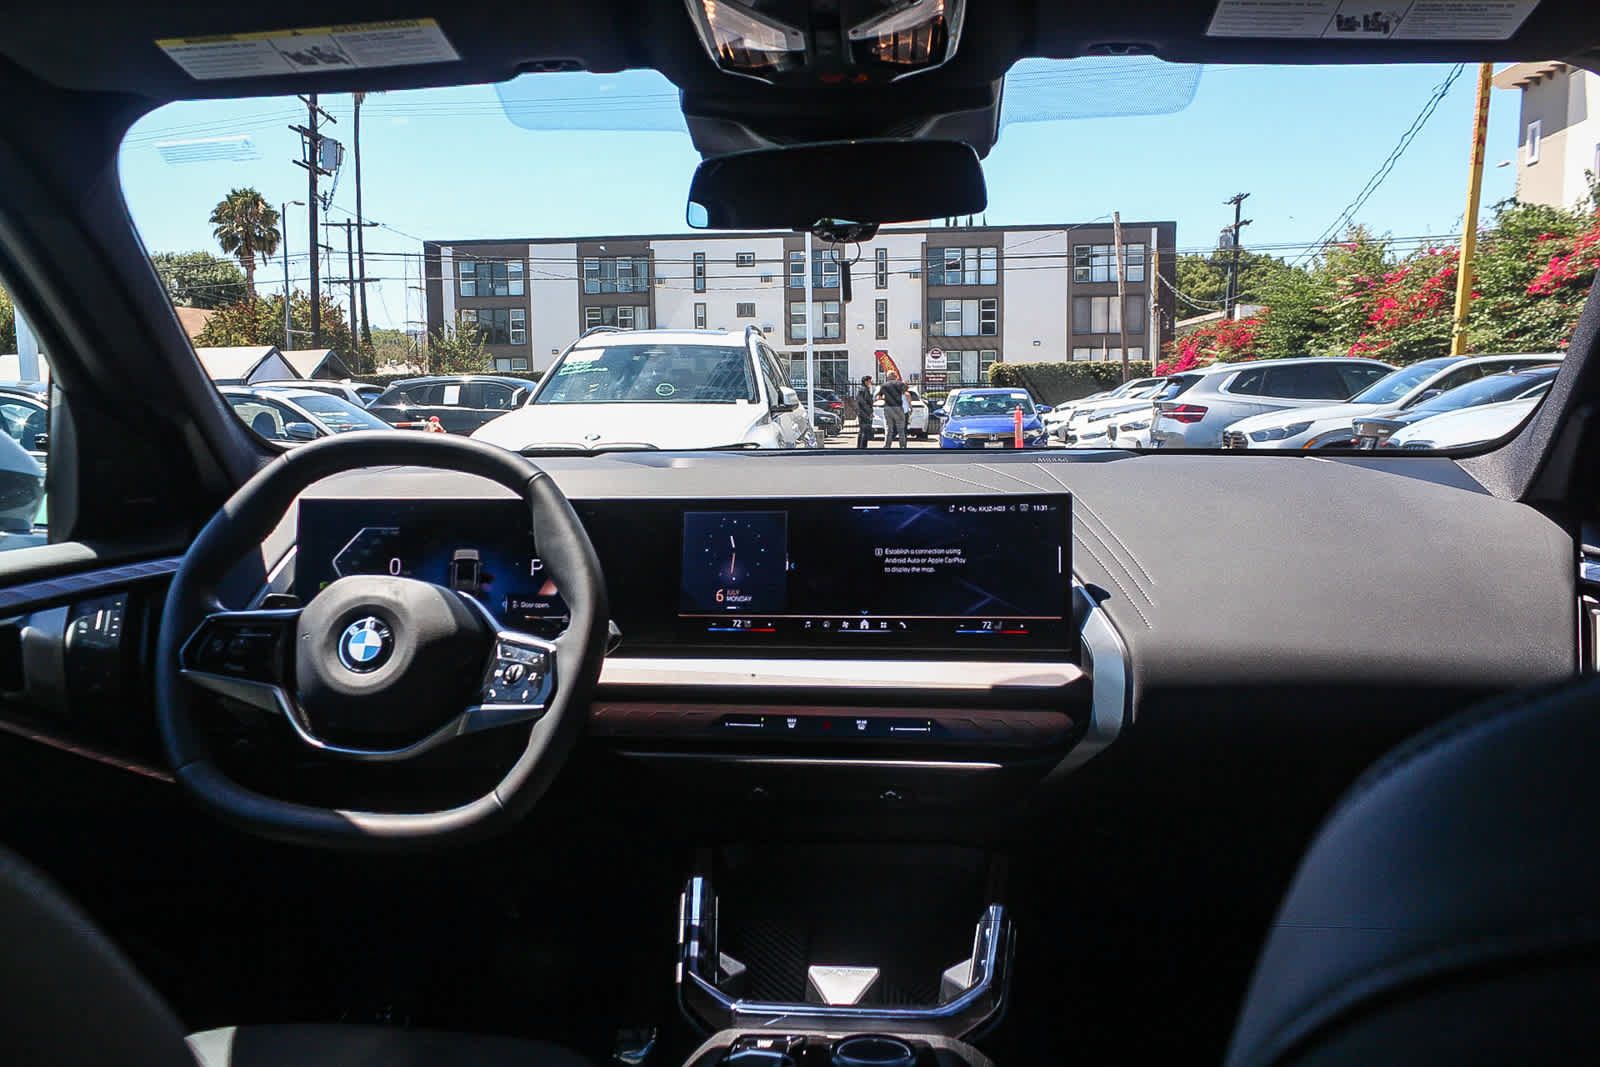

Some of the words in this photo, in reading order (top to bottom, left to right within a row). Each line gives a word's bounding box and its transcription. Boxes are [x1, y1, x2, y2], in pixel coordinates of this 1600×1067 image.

[885, 548, 910, 556] Establish
[915, 548, 944, 556] connection
[945, 549, 961, 557] using
[884, 557, 907, 565] Android
[907, 557, 921, 565] Auto
[927, 557, 944, 566] Apple
[944, 557, 967, 566] CarPlay
[389, 557, 401, 576] 0
[529, 558, 544, 576] P
[891, 566, 910, 575] display
[911, 566, 921, 574] the
[716, 588, 724, 602] 6
[726, 594, 753, 602] MONDAY
[520, 600, 534, 609] Door
[347, 615, 392, 638] BMW
[732, 619, 742, 628] 72
[981, 620, 992, 630] 72
